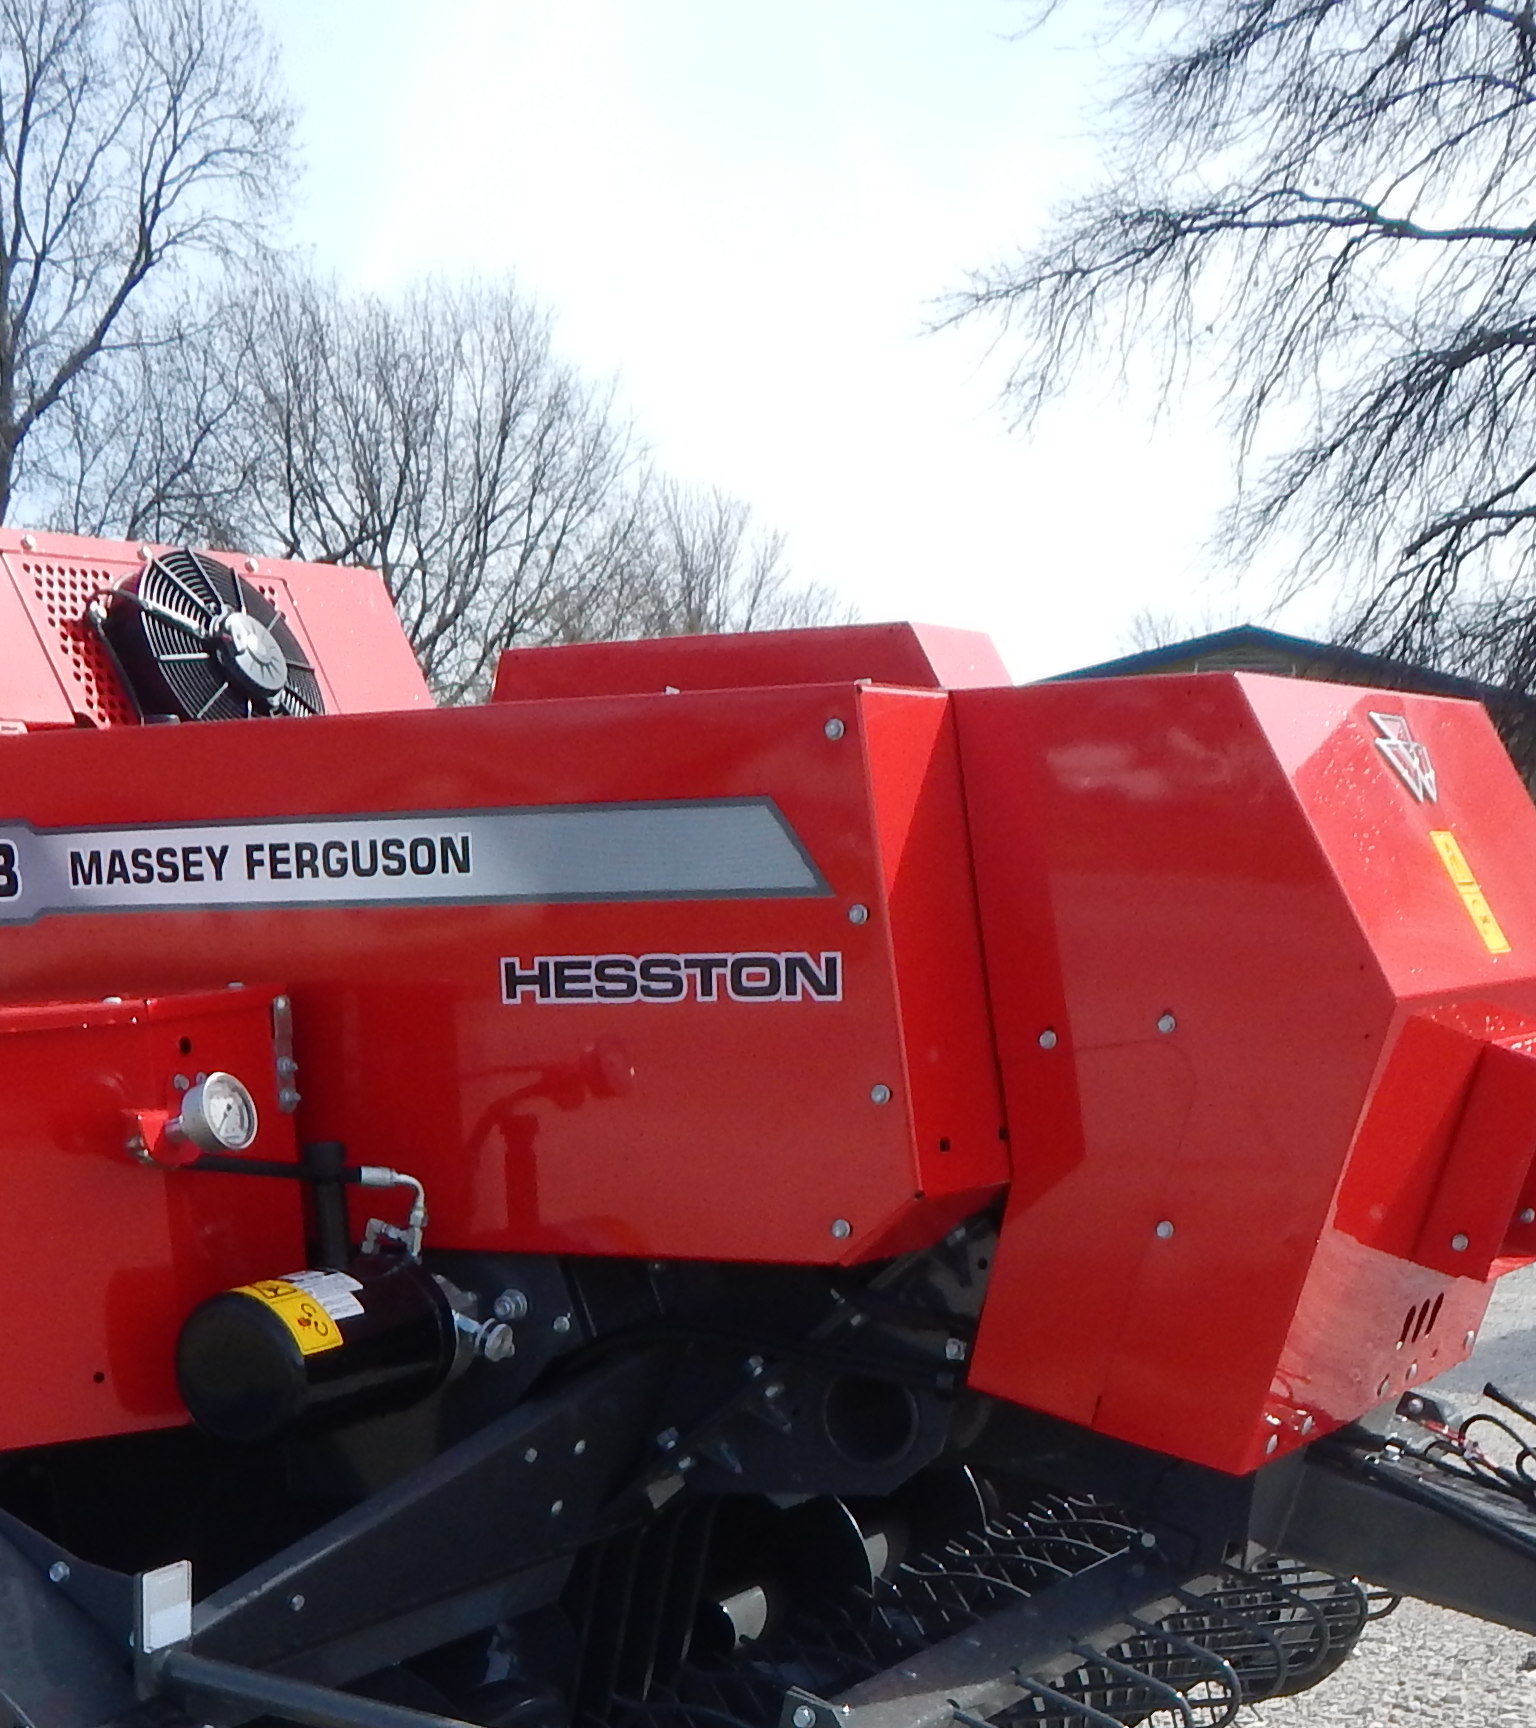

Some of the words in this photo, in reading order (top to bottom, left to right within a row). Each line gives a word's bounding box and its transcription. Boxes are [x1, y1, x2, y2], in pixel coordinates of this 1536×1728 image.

[69, 845, 230, 886] MASSEY
[245, 835, 472, 880] FERGUSON
[502, 953, 841, 1002] HESSTON
